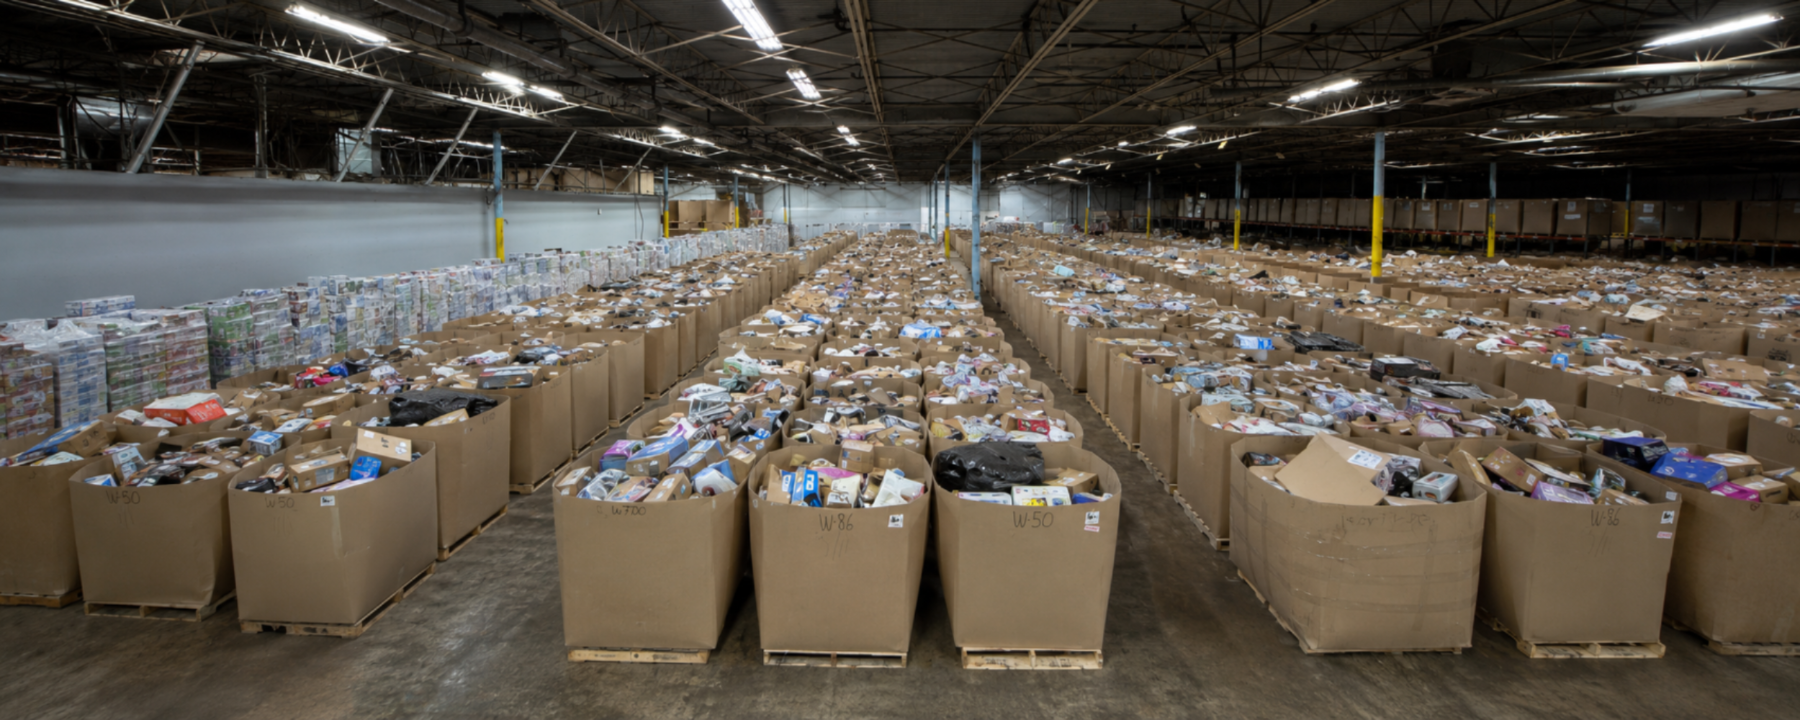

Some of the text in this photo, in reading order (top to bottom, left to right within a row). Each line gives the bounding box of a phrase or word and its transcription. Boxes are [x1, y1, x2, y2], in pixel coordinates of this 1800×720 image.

[106, 490, 141, 504] W-50
[819, 513, 854, 531] W-86
[1013, 511, 1054, 528] W-50
